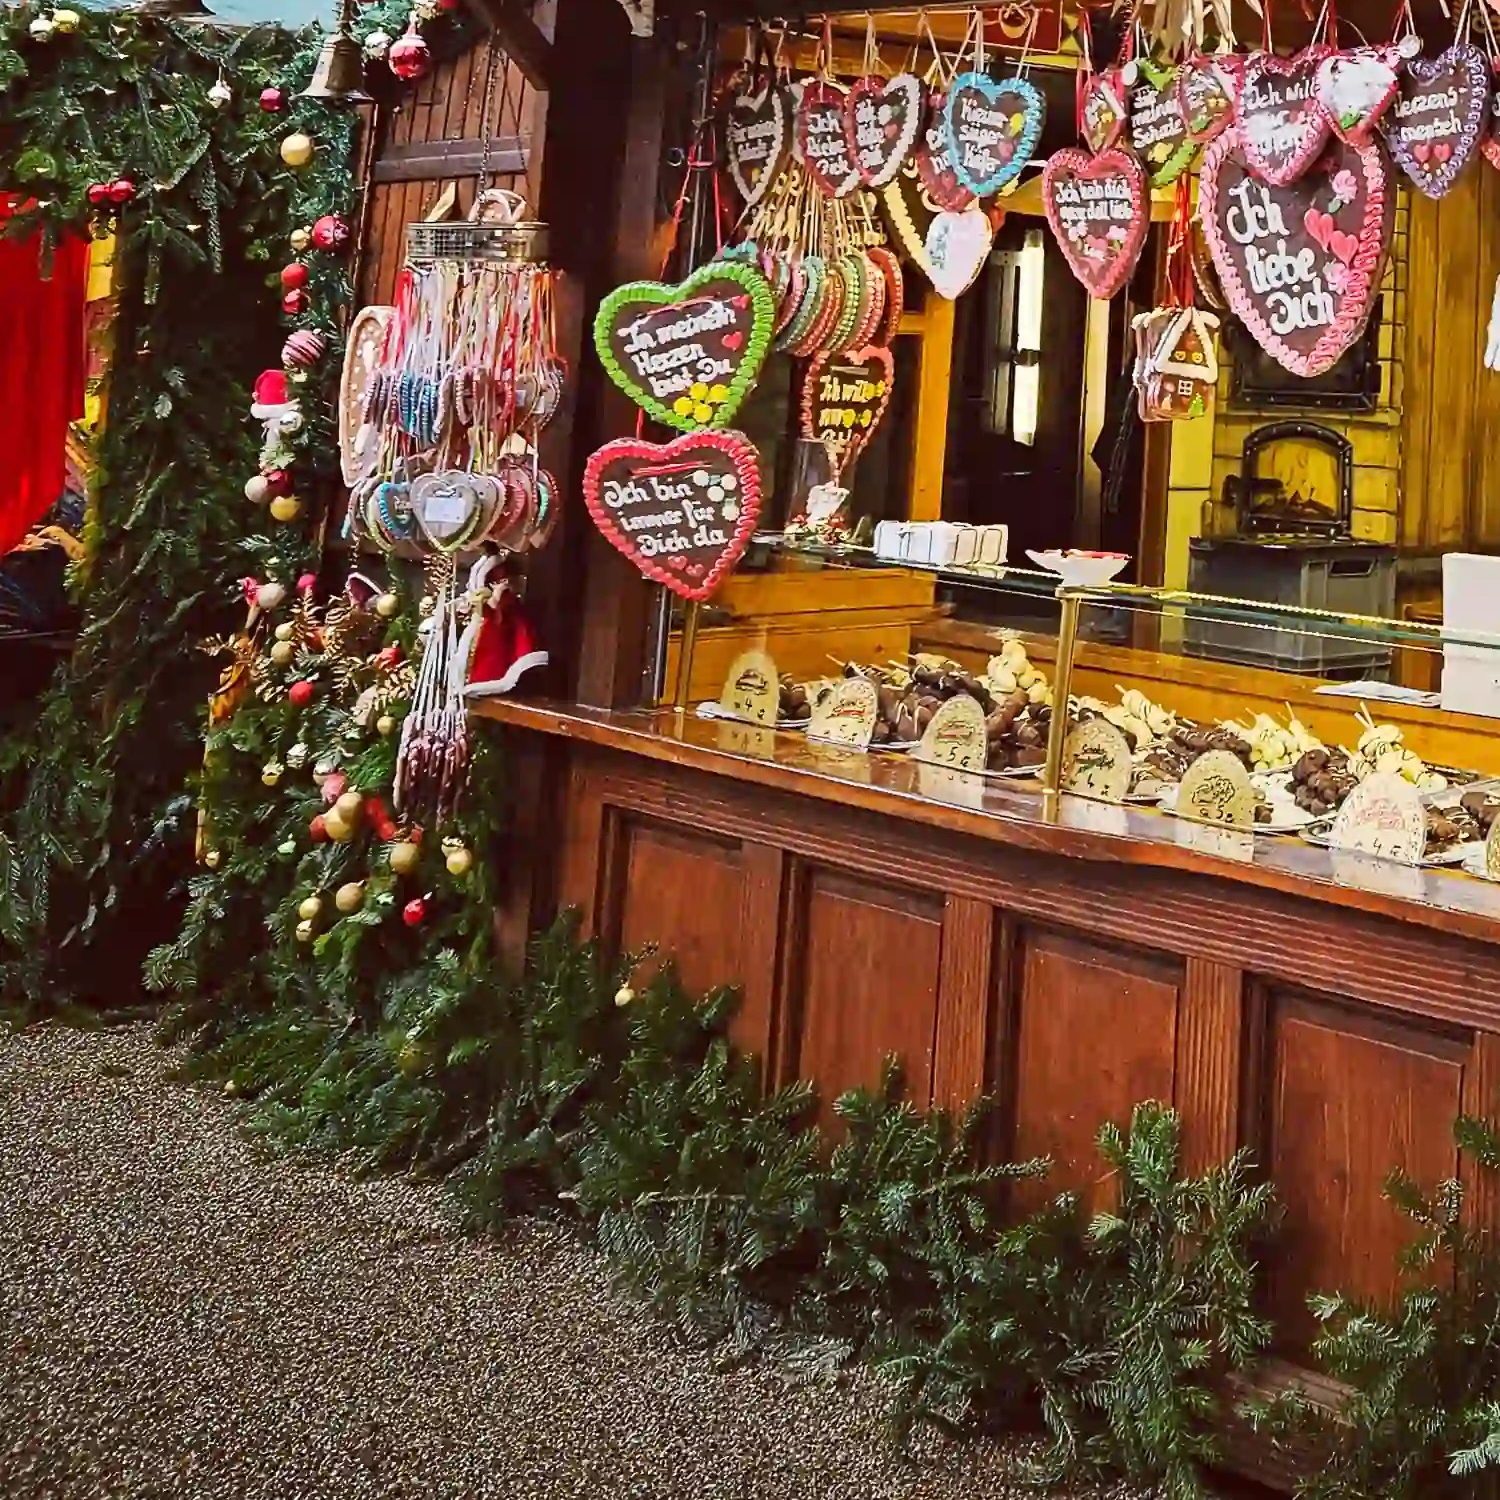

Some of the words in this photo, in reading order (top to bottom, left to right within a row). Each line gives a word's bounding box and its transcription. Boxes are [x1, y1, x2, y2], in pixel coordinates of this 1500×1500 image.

[1227, 177, 1290, 243] Ich
[1245, 239, 1317, 294] liebe
[1265, 277, 1336, 335] Dich
[631, 343, 707, 376] Herzen
[604, 480, 651, 508] Ich
[650, 476, 694, 501] bin
[617, 510, 683, 531] immer
[681, 498, 715, 528] für
[694, 525, 728, 547] da
